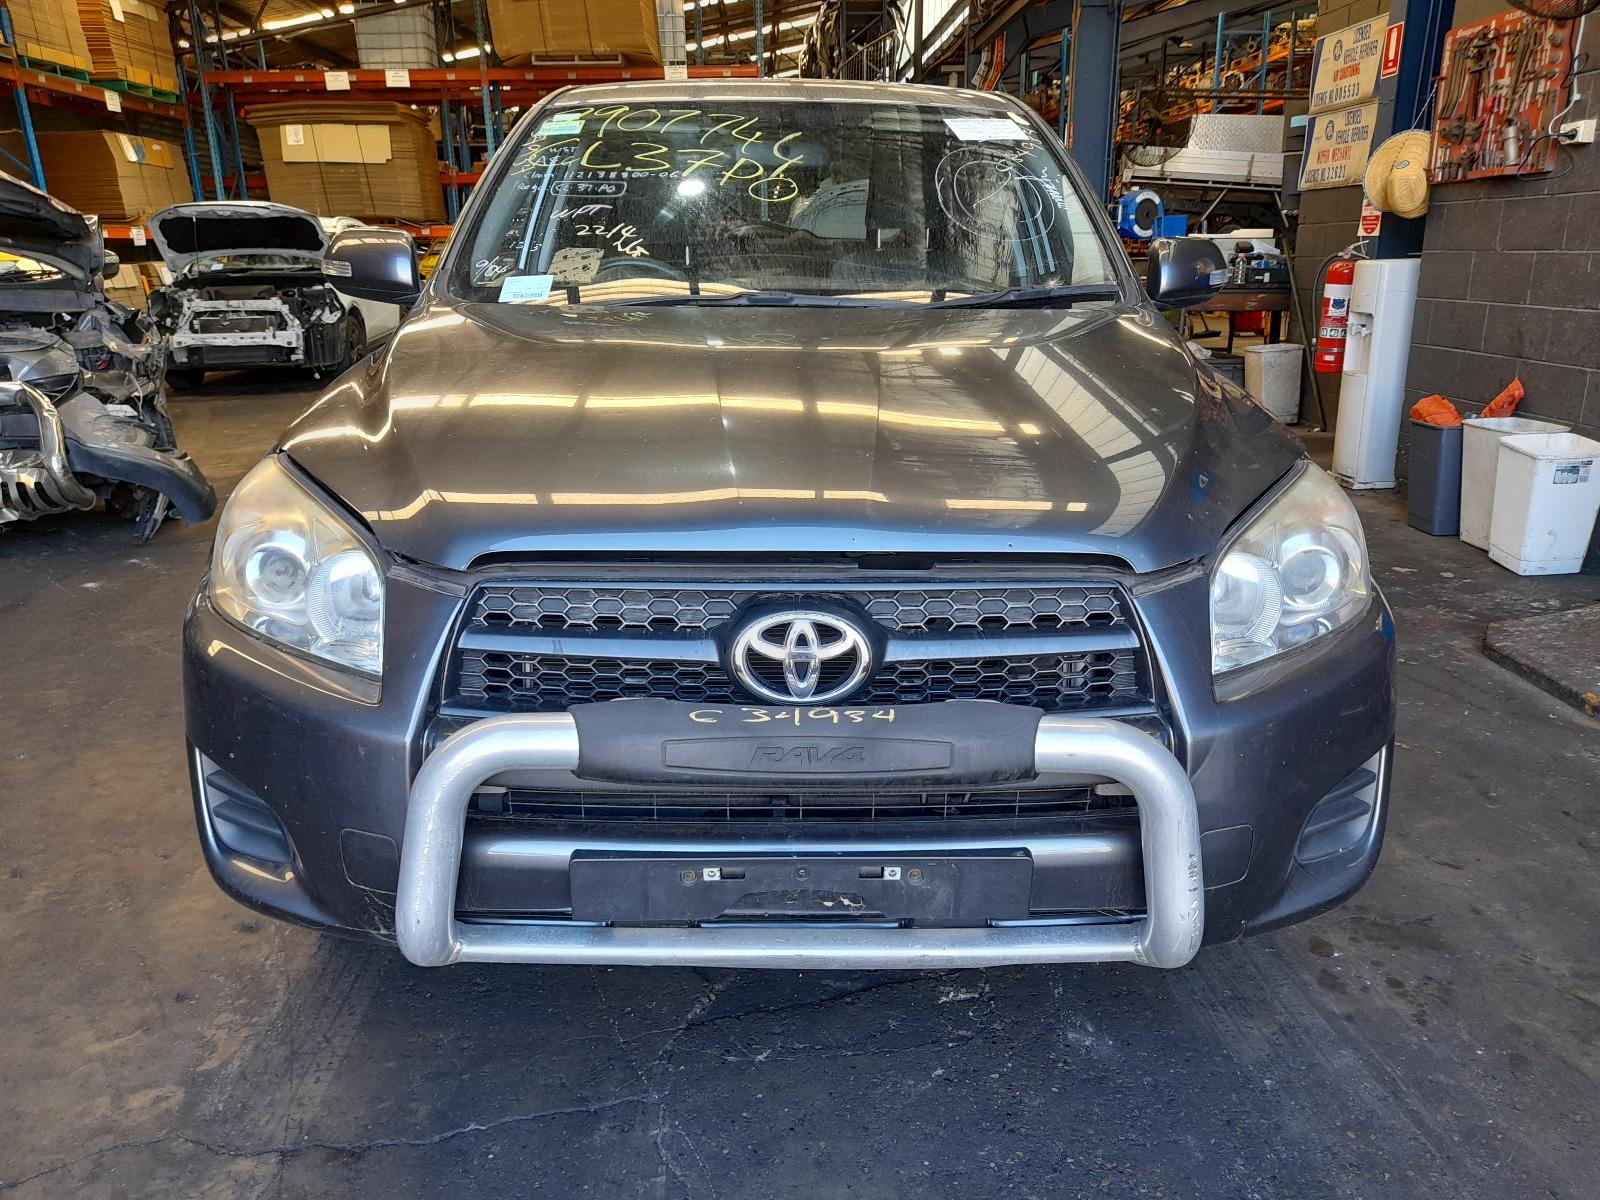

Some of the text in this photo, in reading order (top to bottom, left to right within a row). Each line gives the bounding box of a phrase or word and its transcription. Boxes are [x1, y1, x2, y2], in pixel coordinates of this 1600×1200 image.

[1344, 46, 1359, 64] VEHICLE
[1335, 82, 1360, 102] 005533
[1336, 129, 1351, 145] VEHICLE
[1327, 165, 1346, 180] 32621
[751, 745, 866, 766] RAV4
